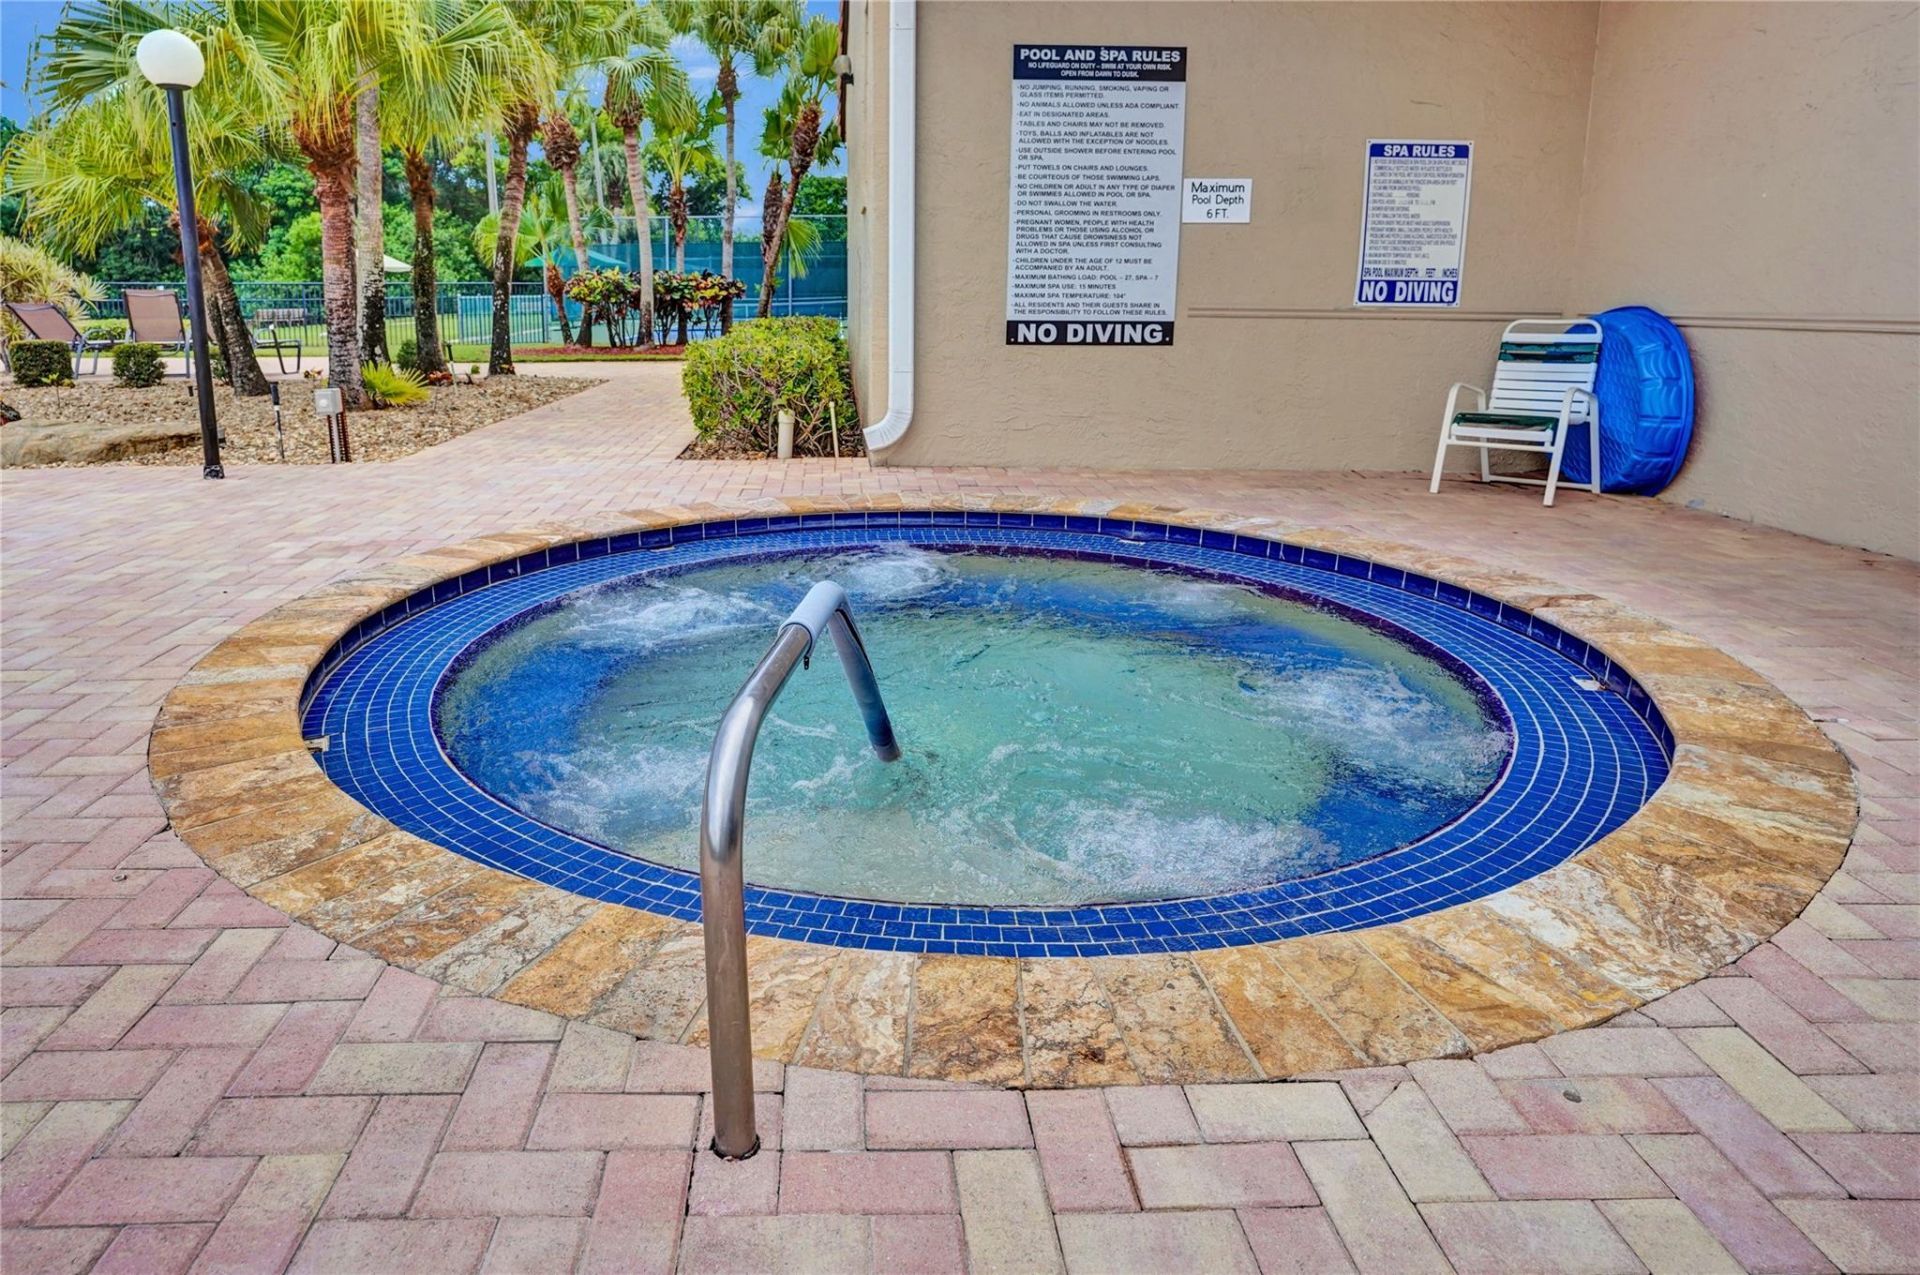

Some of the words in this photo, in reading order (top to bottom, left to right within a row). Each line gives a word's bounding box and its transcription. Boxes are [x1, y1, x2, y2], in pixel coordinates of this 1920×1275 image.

[1020, 49, 1061, 60] POOL
[1064, 49, 1095, 61] AND
[1099, 49, 1128, 61] SPA
[1131, 50, 1181, 62] RULES
[1384, 145, 1409, 157] SPA
[1412, 145, 1456, 158] RULES
[1191, 181, 1245, 193] Maximum
[1192, 194, 1211, 204] Pool
[1216, 194, 1245, 206] Depth
[1206, 208, 1214, 219] 6
[1361, 281, 1388, 302] NO
[1394, 281, 1454, 302] DIVING
[1017, 323, 1058, 343] NO
[1066, 323, 1164, 343] DIVING
